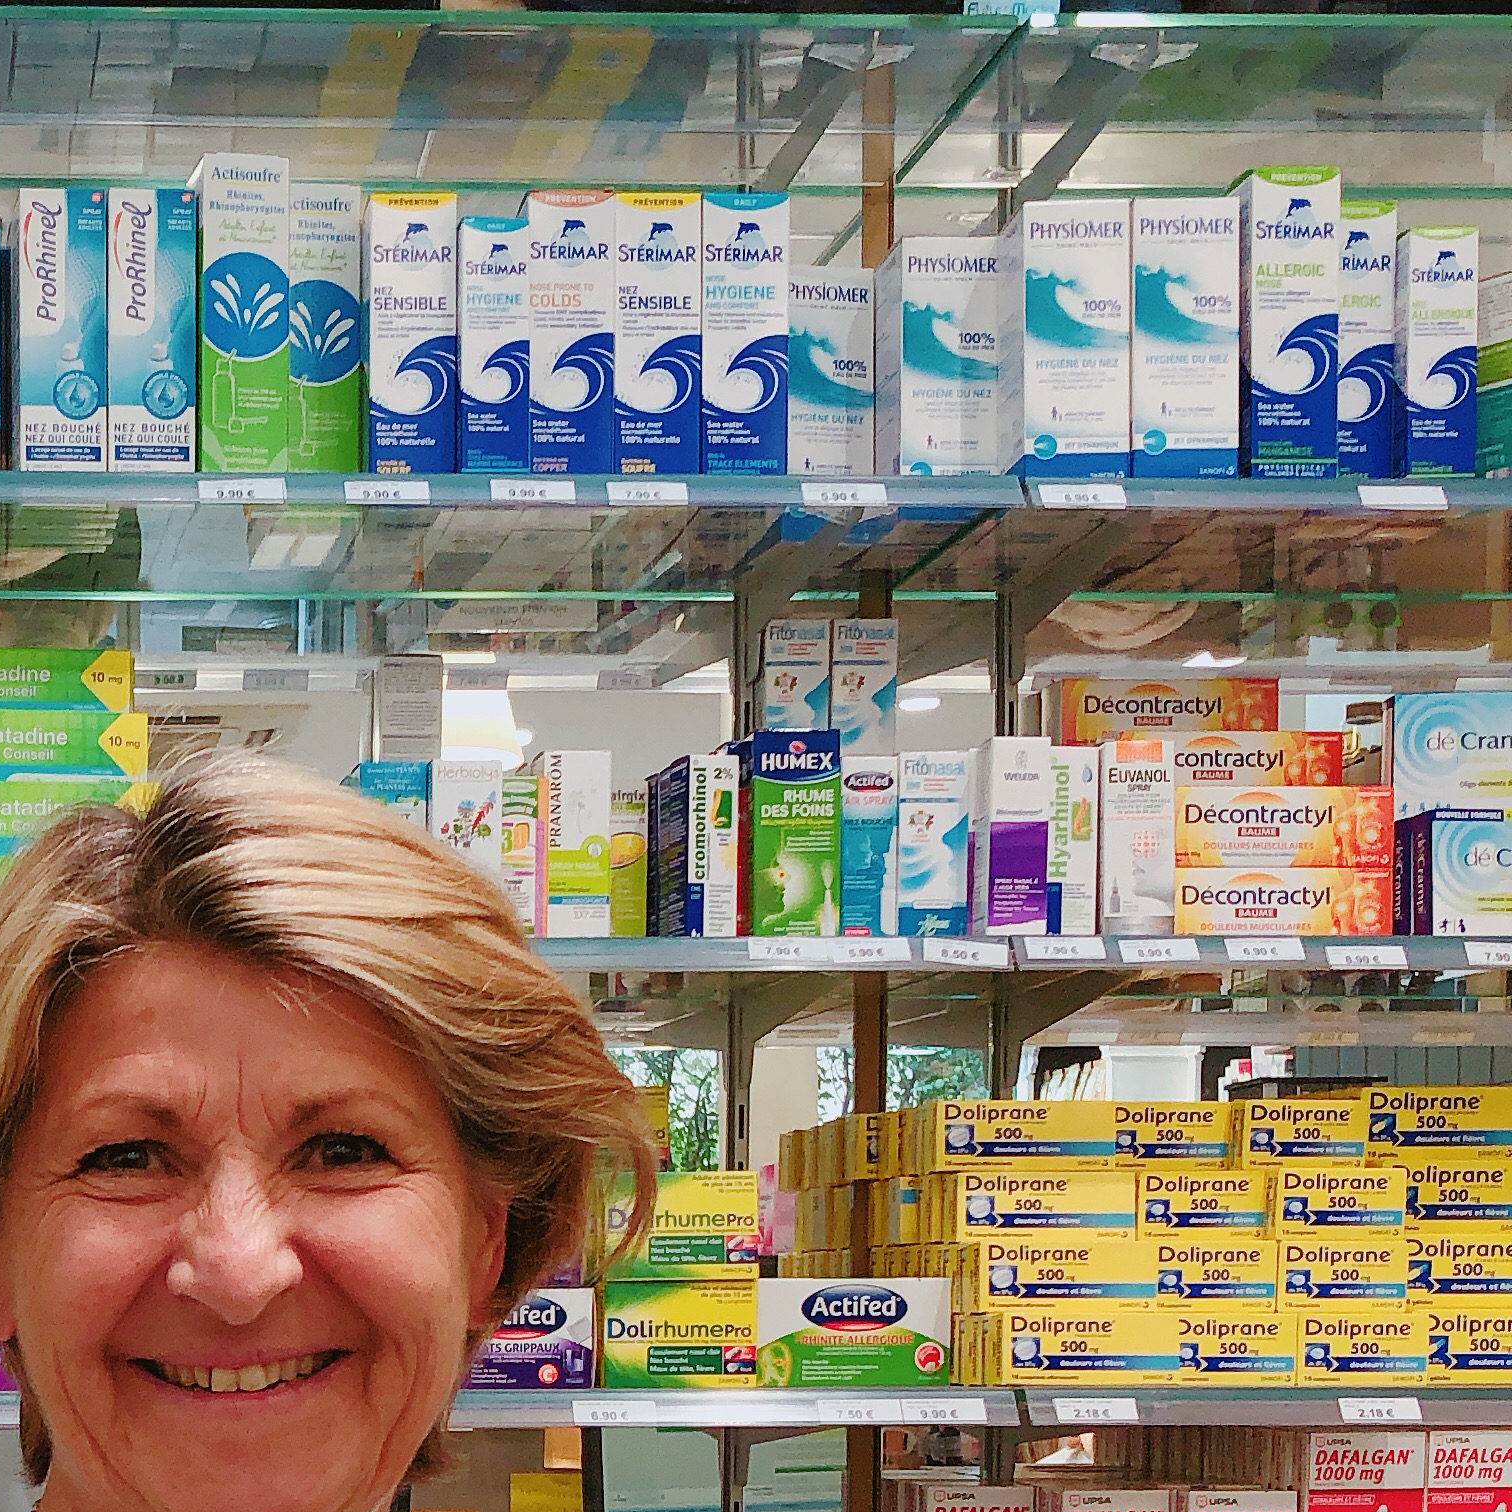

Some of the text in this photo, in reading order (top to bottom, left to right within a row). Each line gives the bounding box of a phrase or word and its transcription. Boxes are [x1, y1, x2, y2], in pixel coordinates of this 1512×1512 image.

[211, 167, 280, 183] Actisoufre
[36, 201, 62, 322] ProRhinel
[1256, 264, 1325, 277] ALLERGIC
[374, 296, 447, 311] SENSIBLE
[530, 294, 582, 308] COLDS
[1083, 299, 1121, 311] 100%
[25, 421, 102, 434] NEZ BOUCHÉ
[25, 434, 102, 445] NEZ QUI COULE
[1084, 695, 1222, 715] Décontractyl
[760, 753, 833, 772] HUMEX
[714, 767, 734, 780] 2%
[847, 773, 890, 788] Actifed
[1108, 767, 1171, 784] EUVANOL
[1127, 783, 1152, 792] SPRAY
[783, 789, 834, 803] RHUME
[761, 803, 834, 817] DES FOINS
[1185, 804, 1333, 825] Décontractyl
[693, 766, 707, 881] cromorhinol
[1050, 763, 1070, 879] Hyarhinol
[1241, 828, 1277, 837] BAUME
[1370, 1092, 1480, 1113] Doliprane
[944, 1104, 1047, 1123] Doliprane
[994, 1128, 1022, 1139] 500
[965, 1175, 1067, 1195] Doliprane
[1146, 1176, 1250, 1195] Doliprane
[607, 1317, 752, 1339] DolirhumePro
[1073, 1409, 1110, 1420] 2.18 €
[1314, 1467, 1384, 1484] 1000 mg
